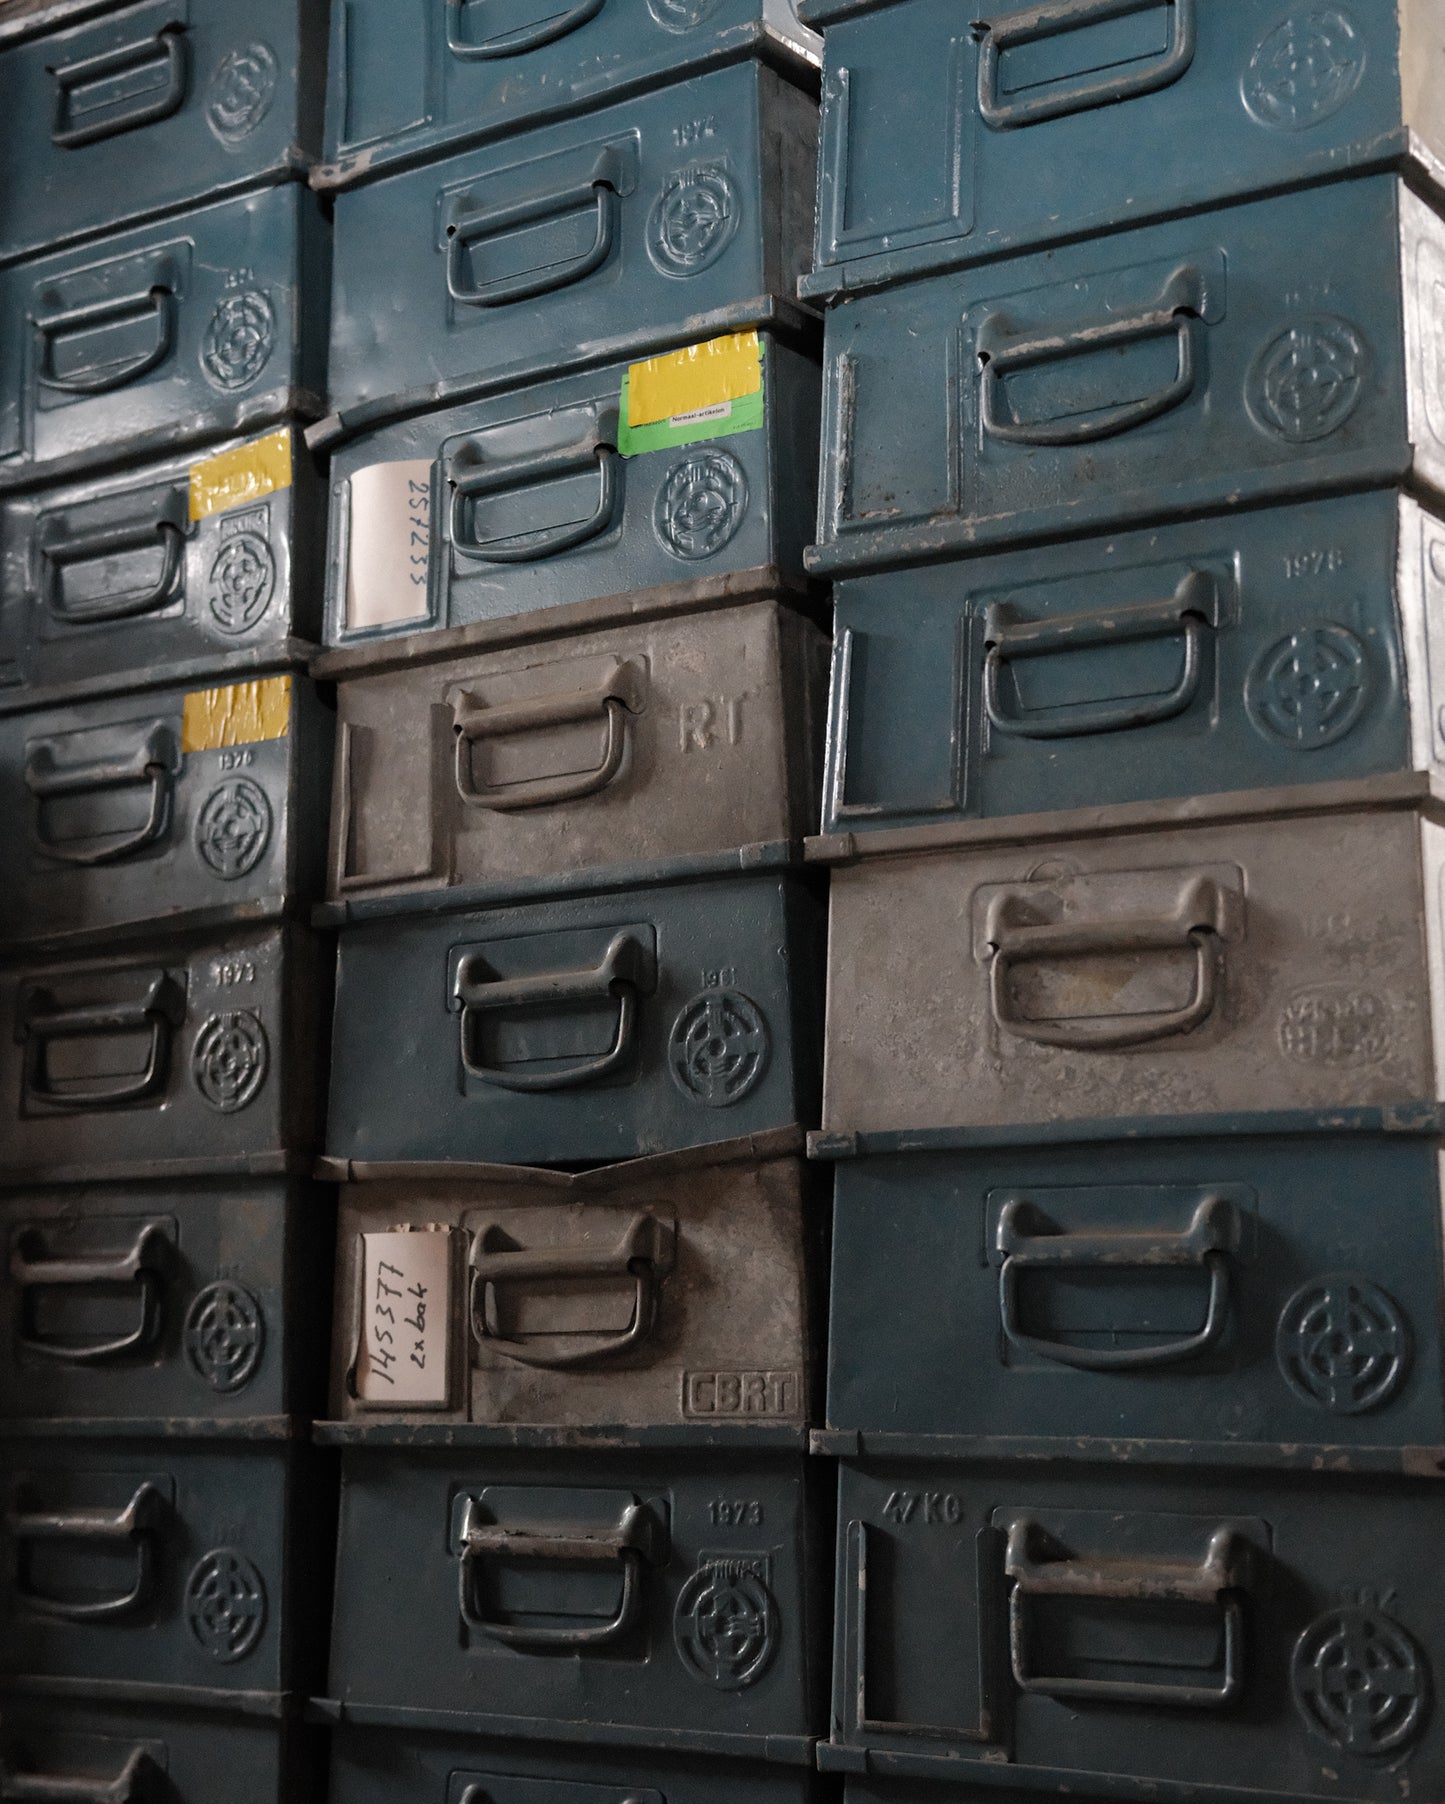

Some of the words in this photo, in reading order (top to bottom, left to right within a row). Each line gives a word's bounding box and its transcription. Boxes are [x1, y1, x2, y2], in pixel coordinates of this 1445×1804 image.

[369, 1260, 404, 1384] 145377
[404, 1282, 428, 1333] bak
[410, 1339, 426, 1369] 2x
[689, 1371, 792, 1412] CBRT
